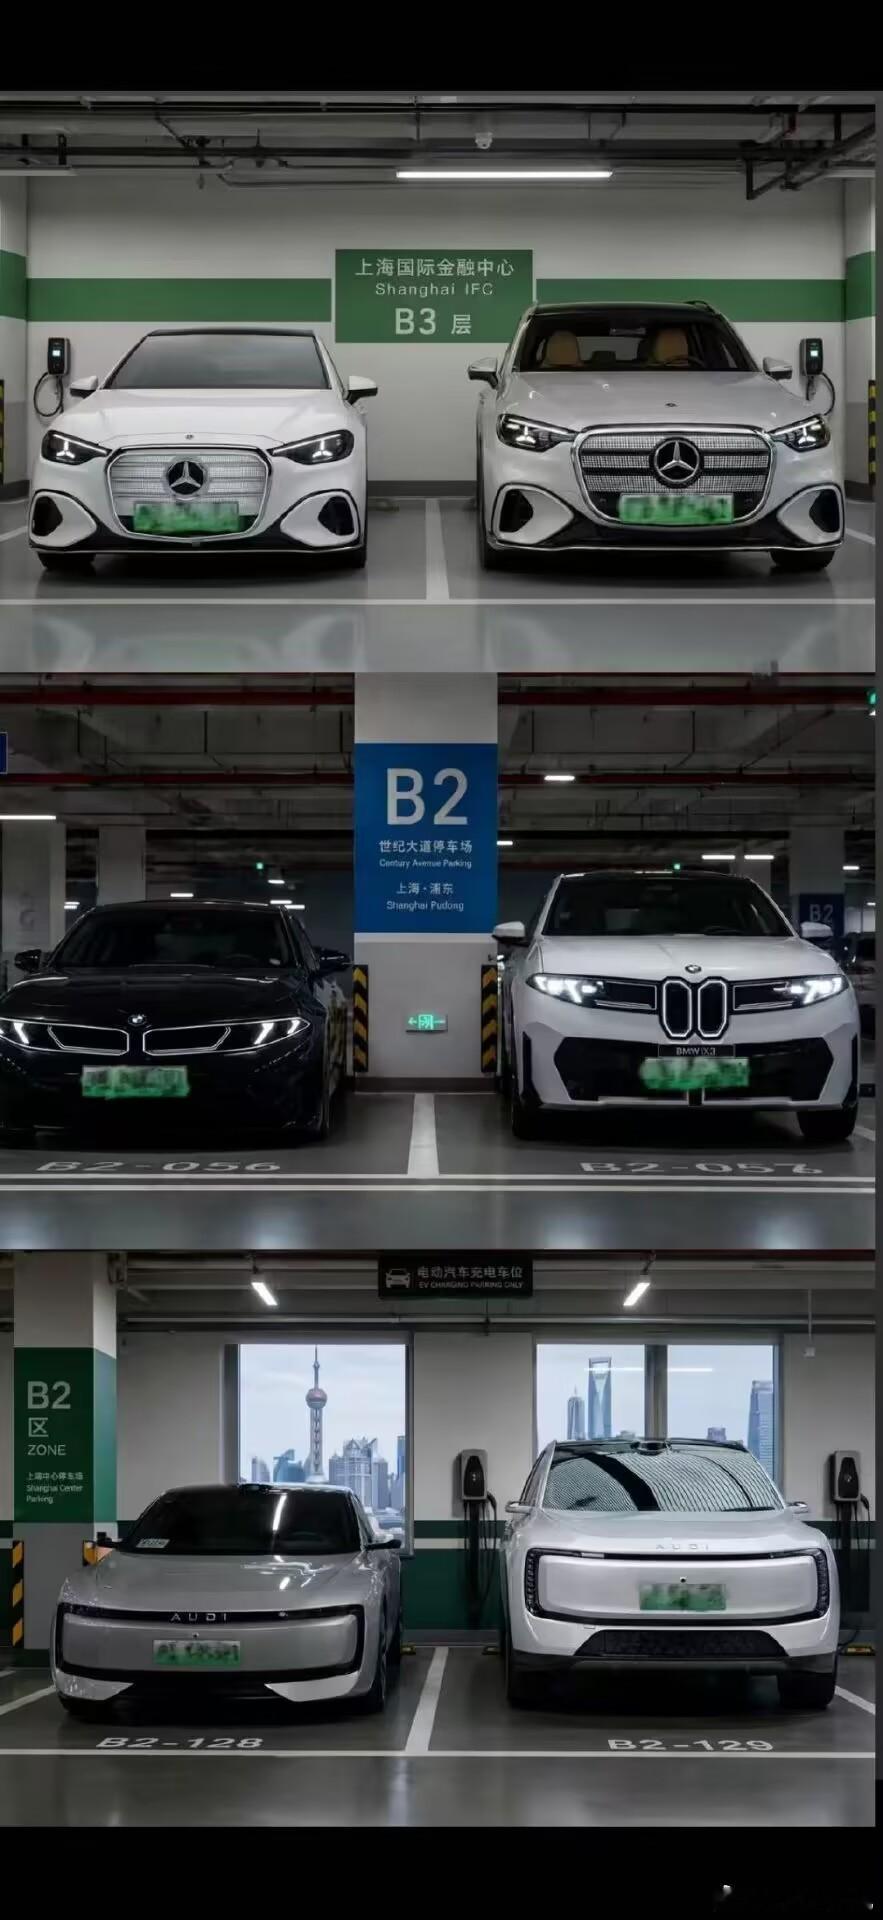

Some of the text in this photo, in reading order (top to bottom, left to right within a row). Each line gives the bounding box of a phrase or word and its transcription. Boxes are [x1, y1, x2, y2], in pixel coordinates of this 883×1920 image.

[355, 258, 514, 277] 上海国际金融中心
[375, 282, 493, 298] Shanghai IFC
[395, 308, 472, 335] B3 层
[387, 768, 468, 825] B2
[379, 840, 473, 853] 世纪大道停车场
[379, 858, 410, 869] Century
[443, 859, 472, 869] Parking
[386, 901, 464, 912] Shanghai Pudong
[36, 1161, 281, 1171] B2-056
[27, 1381, 72, 1409] B2
[28, 1417, 49, 1437] 区
[27, 1444, 67, 1456] ZONE
[170, 1613, 227, 1621] AUDI
[96, 1737, 263, 1749] B2-128
[608, 1739, 773, 1751] B2-129
